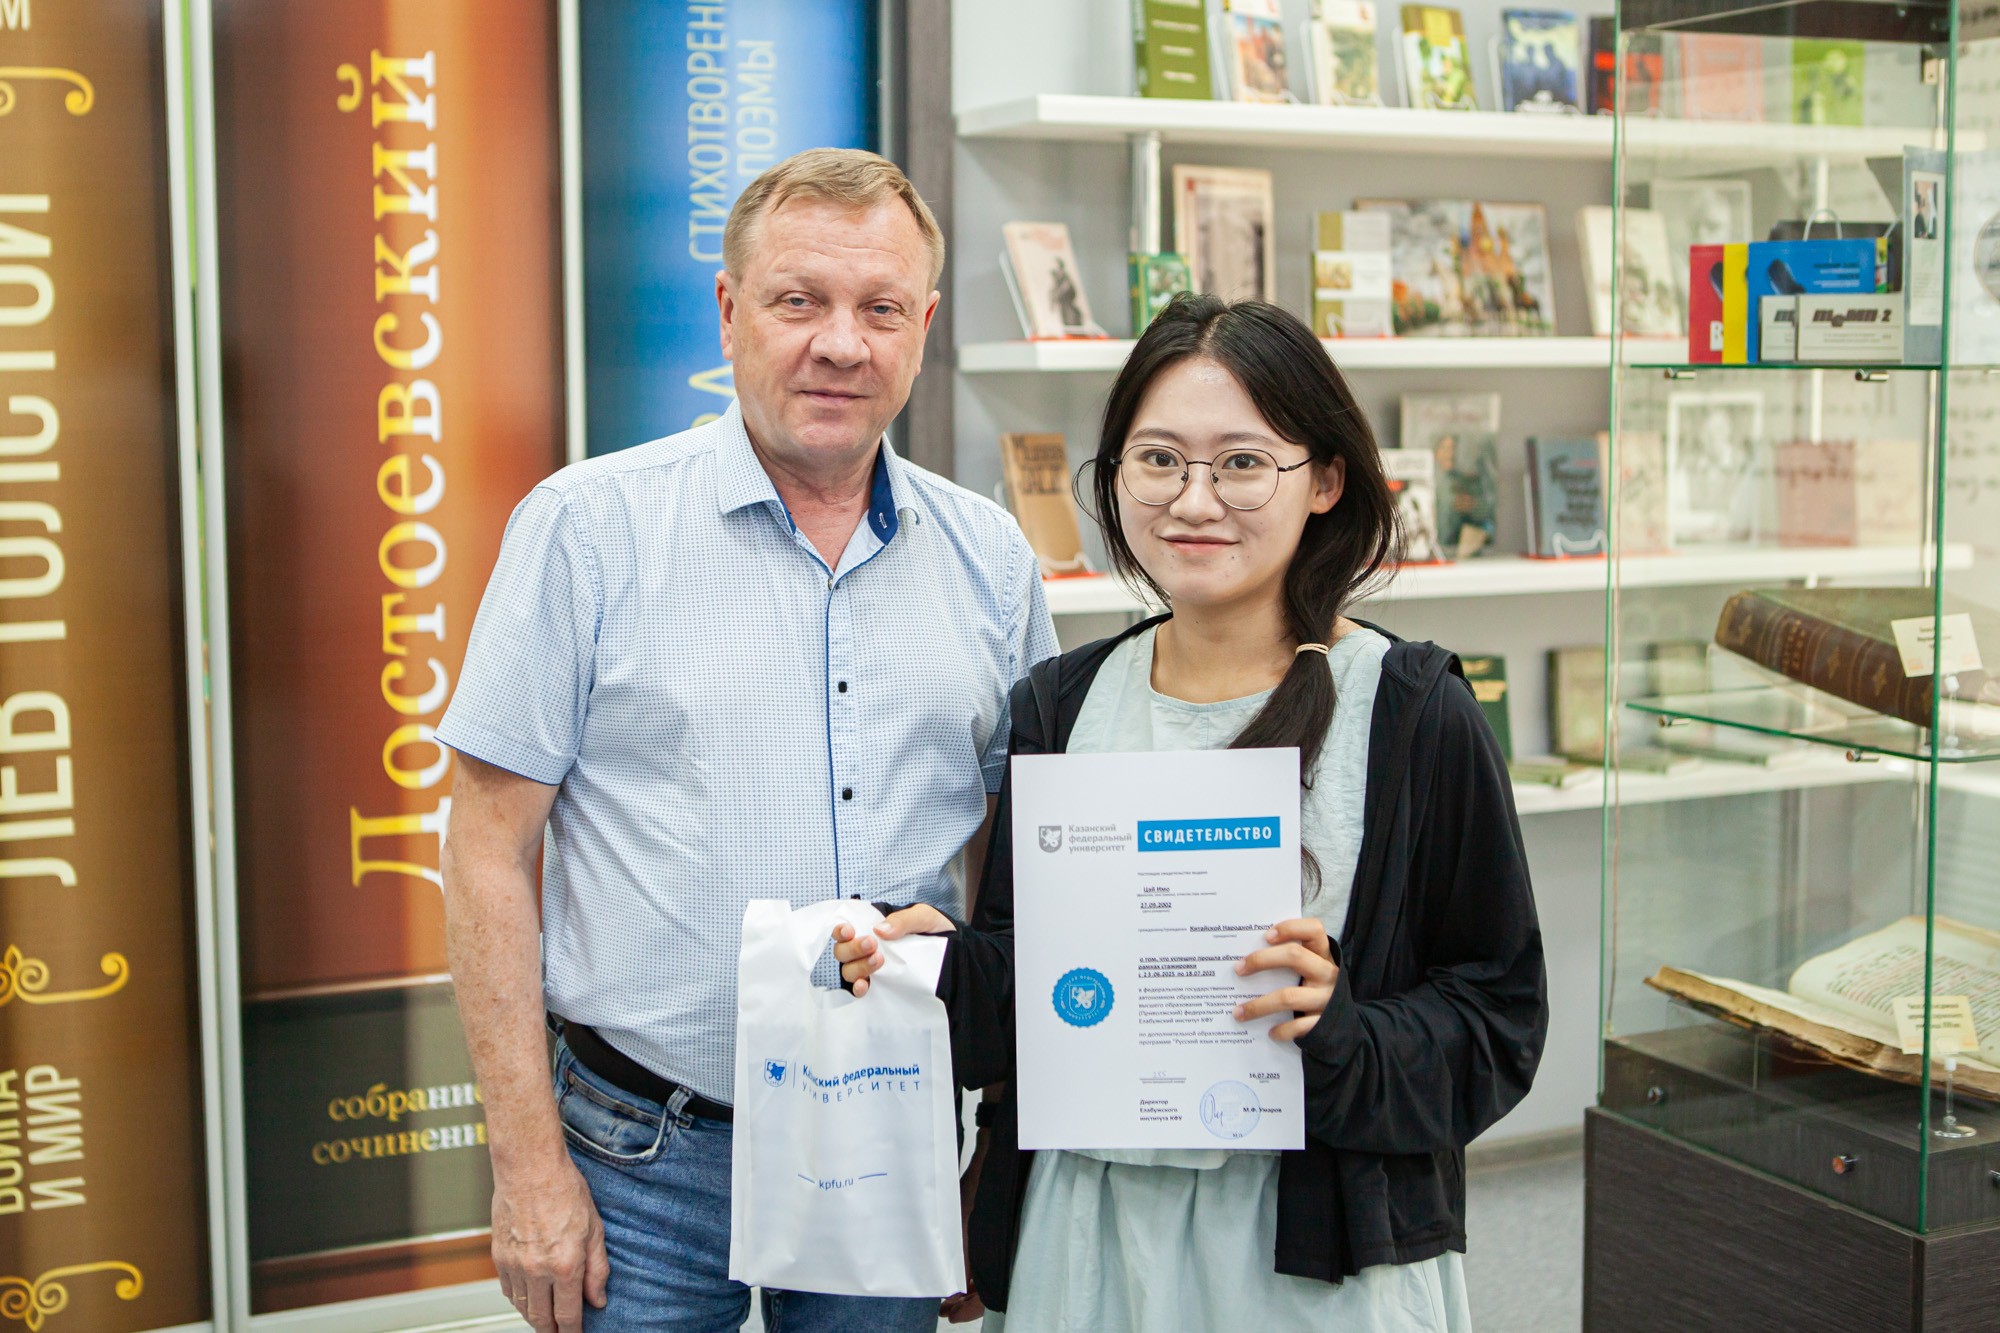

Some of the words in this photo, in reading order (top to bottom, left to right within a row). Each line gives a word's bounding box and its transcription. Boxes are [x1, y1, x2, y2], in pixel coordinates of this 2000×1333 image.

[736, 40, 778, 177] ПОЭМЫ
[687, 0, 729, 263] СТИХОТВОРЕН
[336, 49, 452, 892] Достоевский
[1068, 824, 1116, 833] Казанский
[1068, 833, 1132, 844] федеральный
[1144, 826, 1272, 844] СВИДЕТЕЛЬСТВО
[1068, 844, 1126, 854] университет
[842, 1064, 920, 1085] федеральный
[1249, 1072, 1280, 1080] 16.07.2025
[802, 1081, 920, 1104] УИВЕРСИТЕТ
[24, 1064, 85, 1165] МИР
[312, 1122, 489, 1165] сочинени
[29, 1176, 87, 1210] И
[819, 1178, 854, 1191] kpfu.ru
